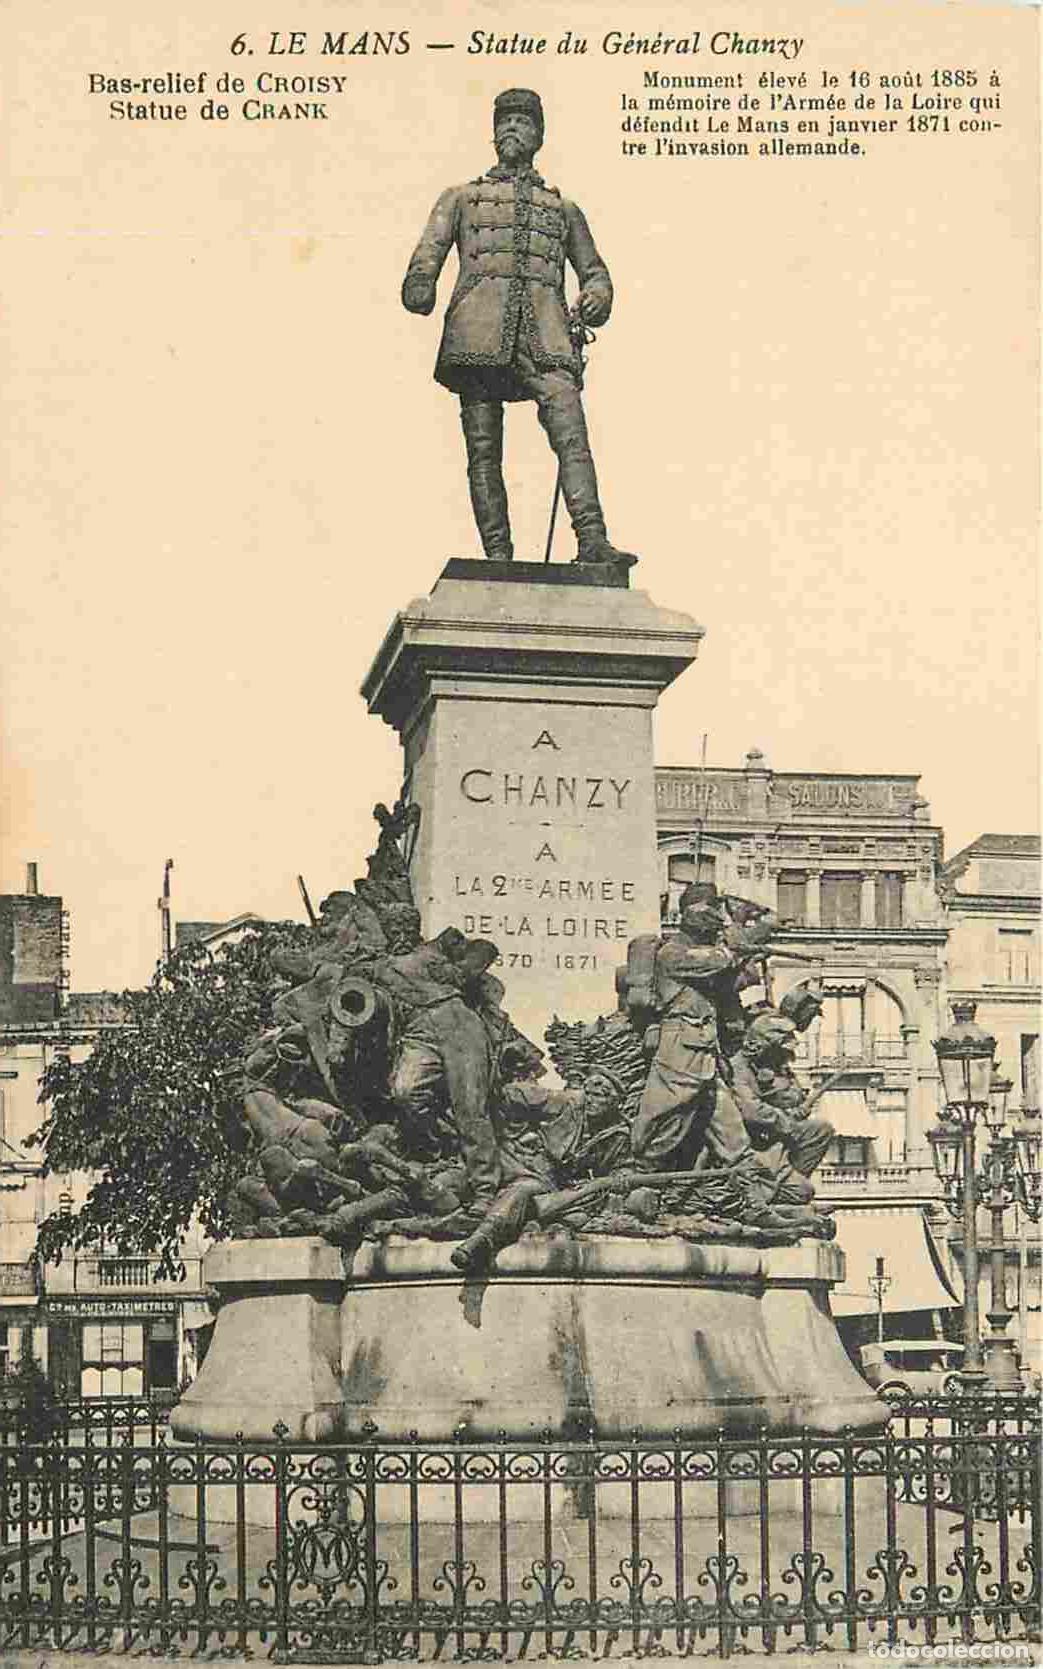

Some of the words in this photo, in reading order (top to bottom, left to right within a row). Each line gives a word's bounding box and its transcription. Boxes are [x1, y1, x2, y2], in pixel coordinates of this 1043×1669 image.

[531, 730, 561, 750] A
[460, 769, 631, 808] CHANZY
[535, 843, 557, 862] A
[455, 876, 484, 897] LA
[464, 915, 493, 935] DE
[503, 915, 534, 937] LA
[546, 917, 628, 939] LOIRE
[555, 955, 599, 970] 1871
